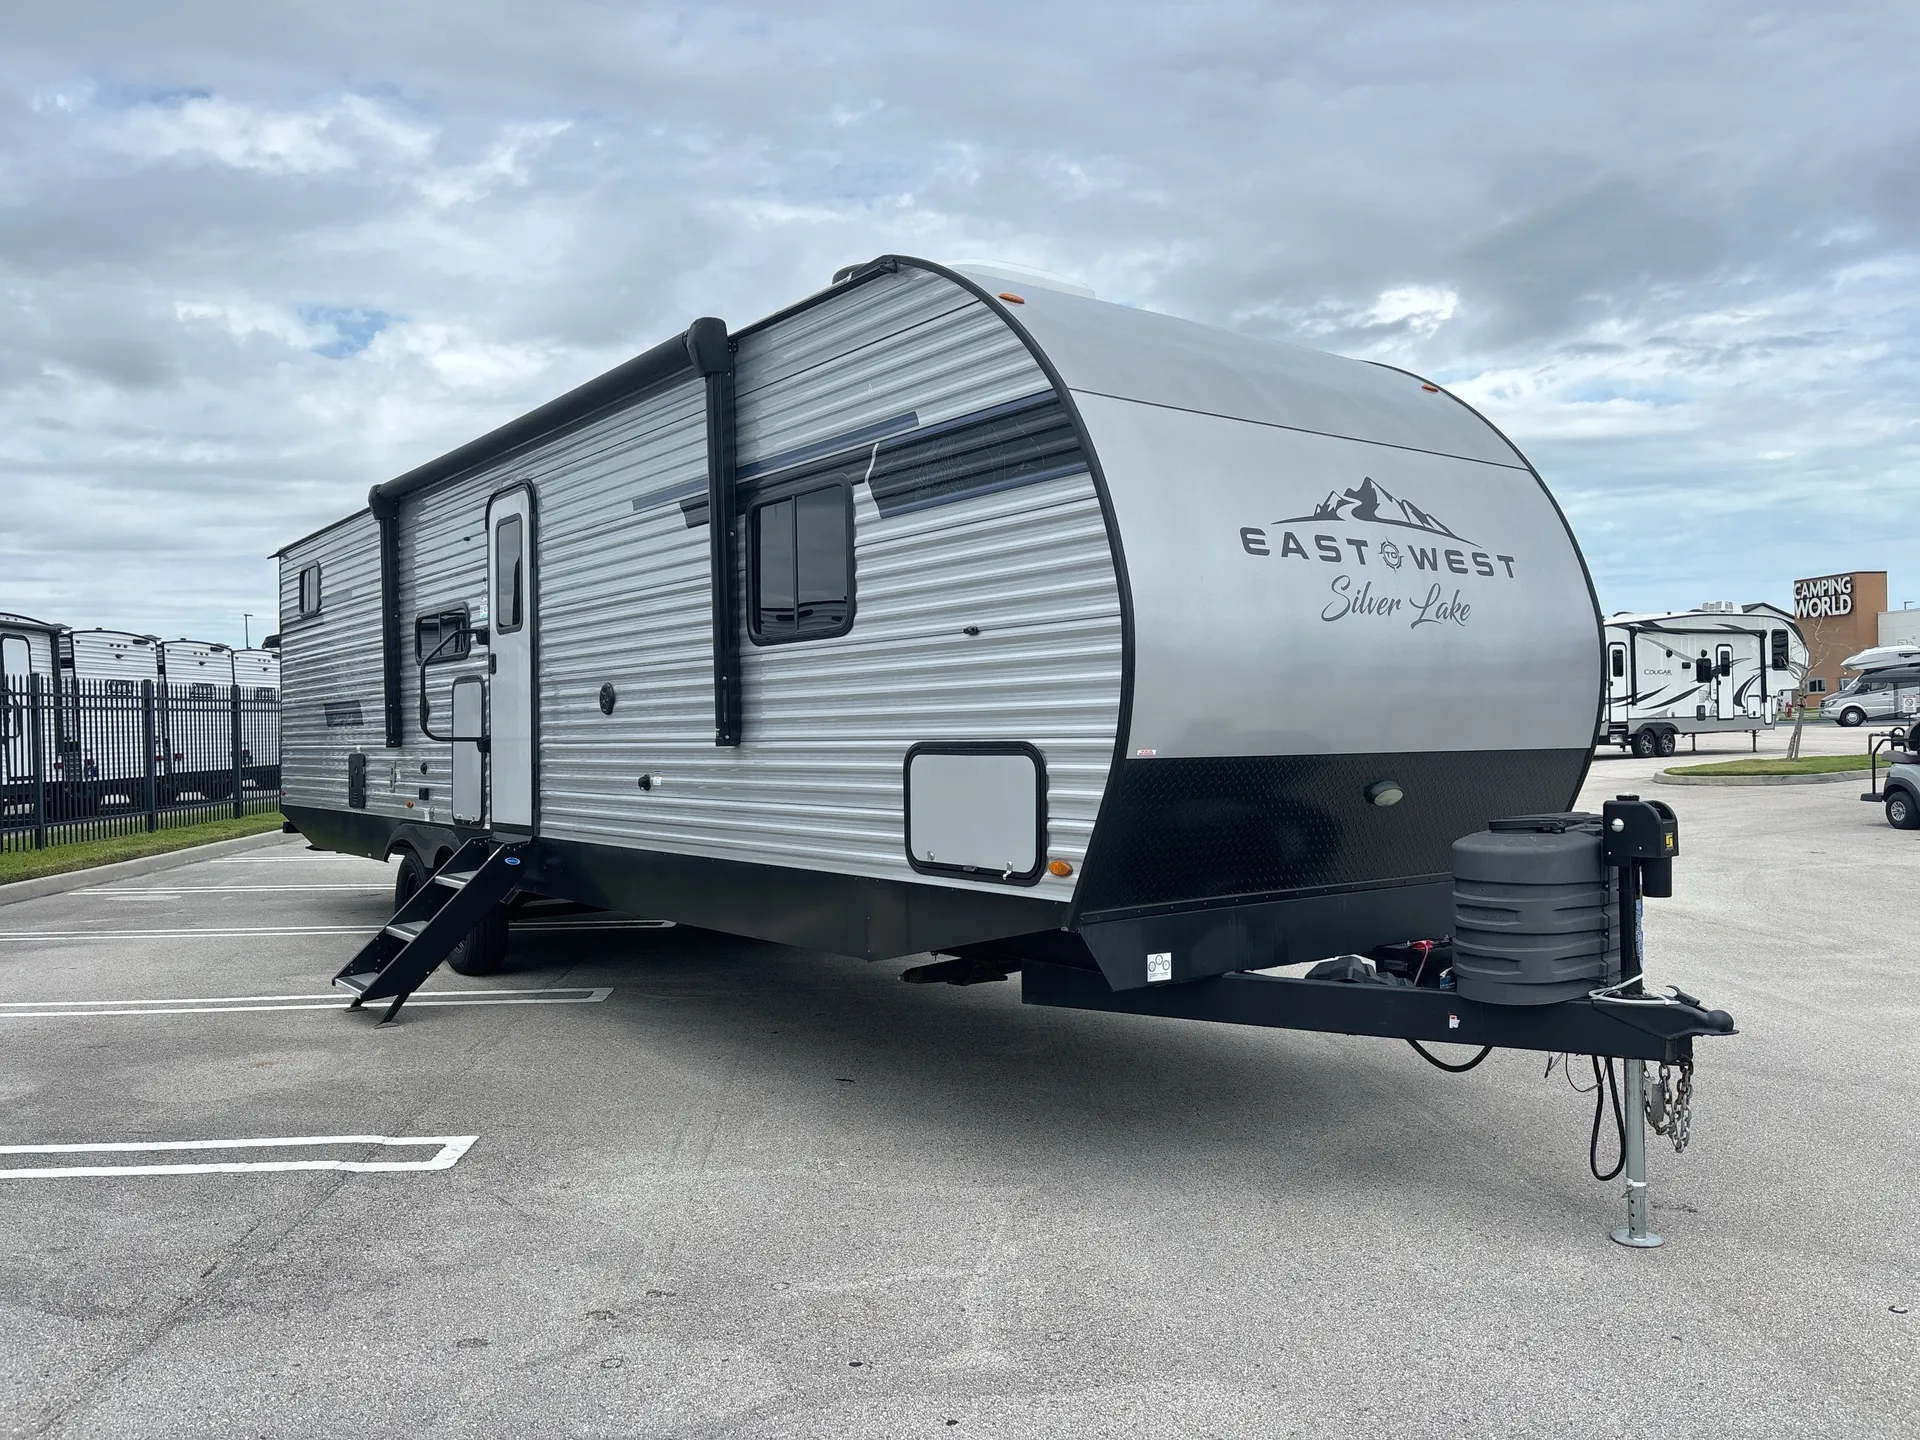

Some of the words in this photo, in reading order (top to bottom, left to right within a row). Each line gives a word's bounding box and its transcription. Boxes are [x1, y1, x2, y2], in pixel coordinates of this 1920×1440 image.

[1239, 526, 1369, 566] EAST
[1384, 551, 1398, 559] TO
[1407, 544, 1516, 579] WEST
[1321, 575, 1402, 622] Silver
[1409, 582, 1472, 630] Lake
[1793, 576, 1852, 600] CAMPING
[1794, 594, 1852, 619] WORLD
